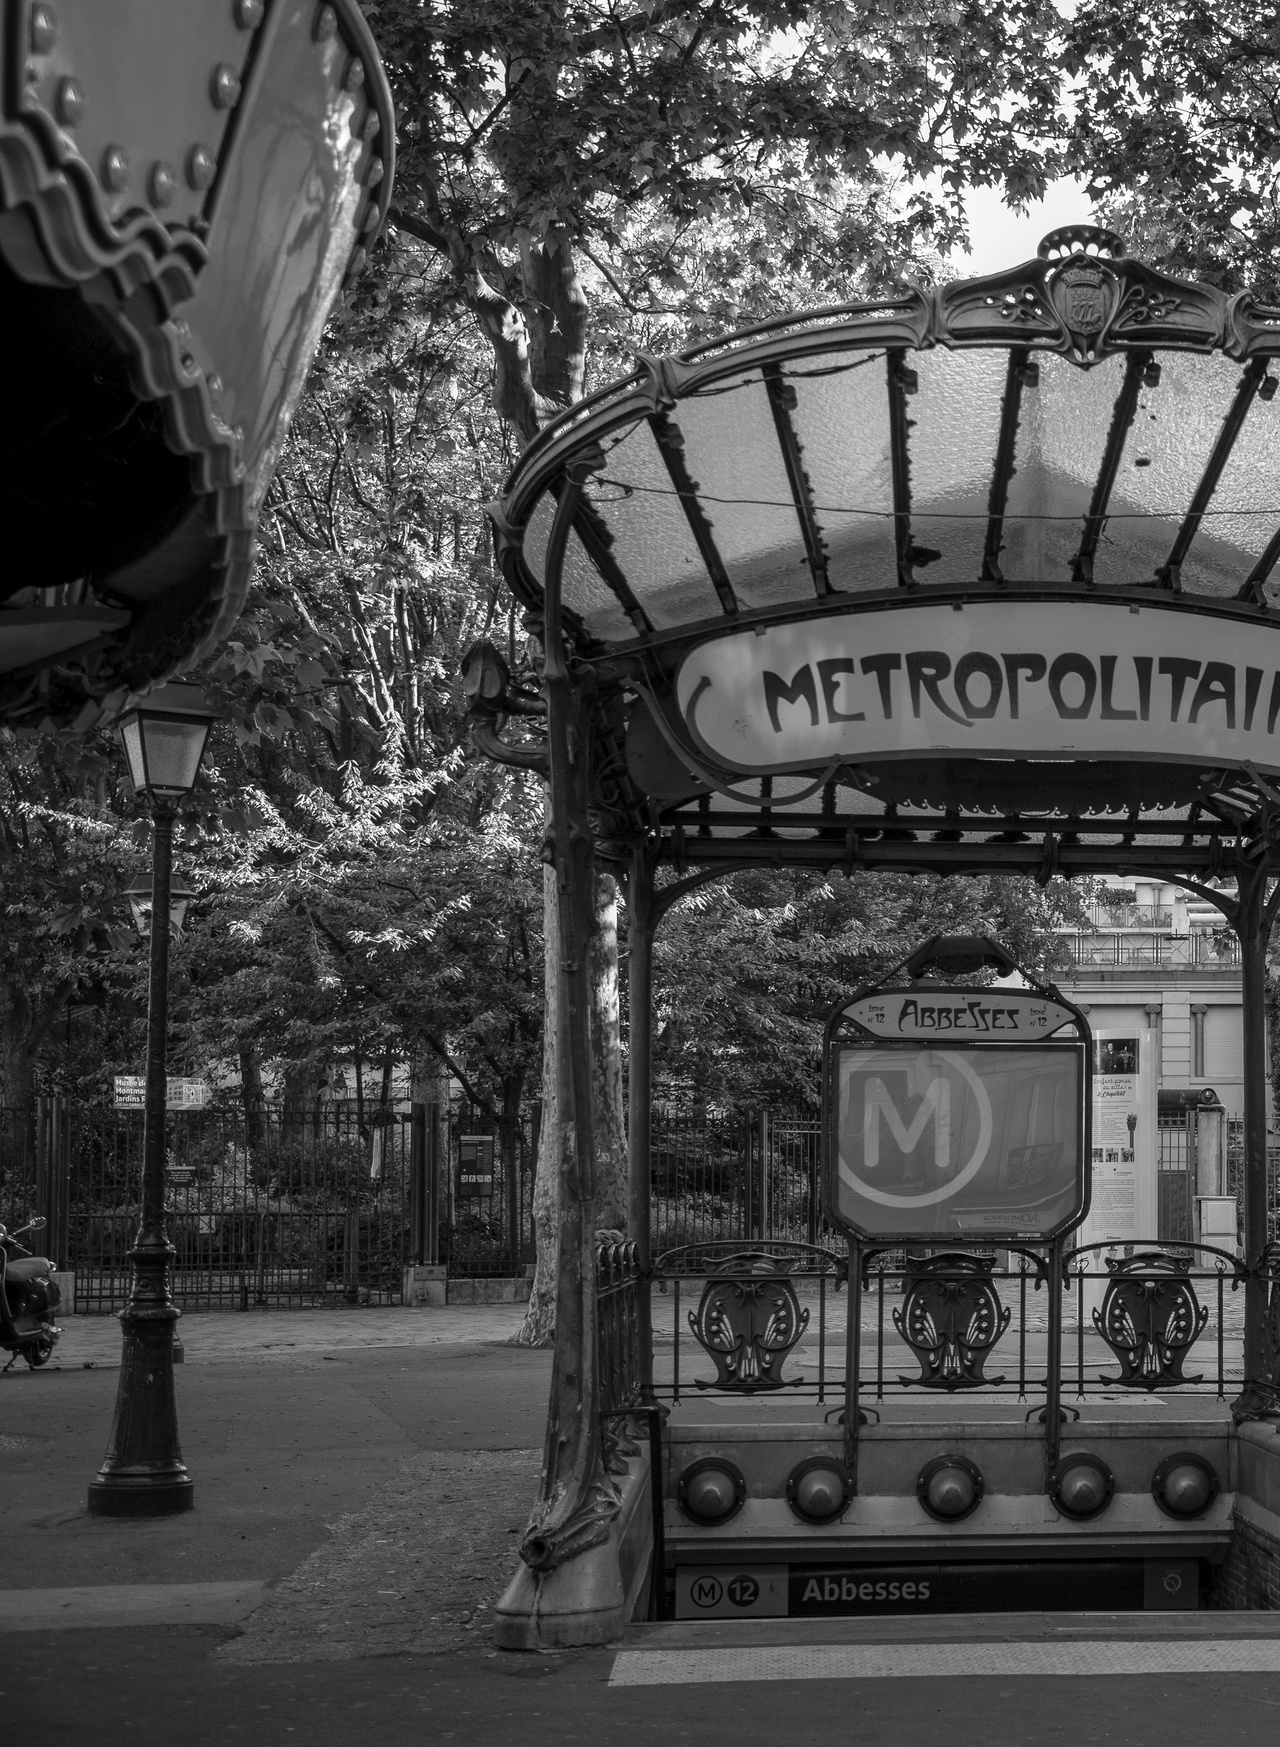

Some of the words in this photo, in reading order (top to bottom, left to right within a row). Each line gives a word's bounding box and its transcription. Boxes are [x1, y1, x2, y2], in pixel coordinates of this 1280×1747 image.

[874, 1013, 885, 1024] 12
[1037, 1016, 1047, 1027] 12
[116, 1095, 140, 1103] Jardins
[698, 1583, 716, 1601] M
[730, 1582, 755, 1601] 12
[802, 1578, 930, 1601] Abbesses
